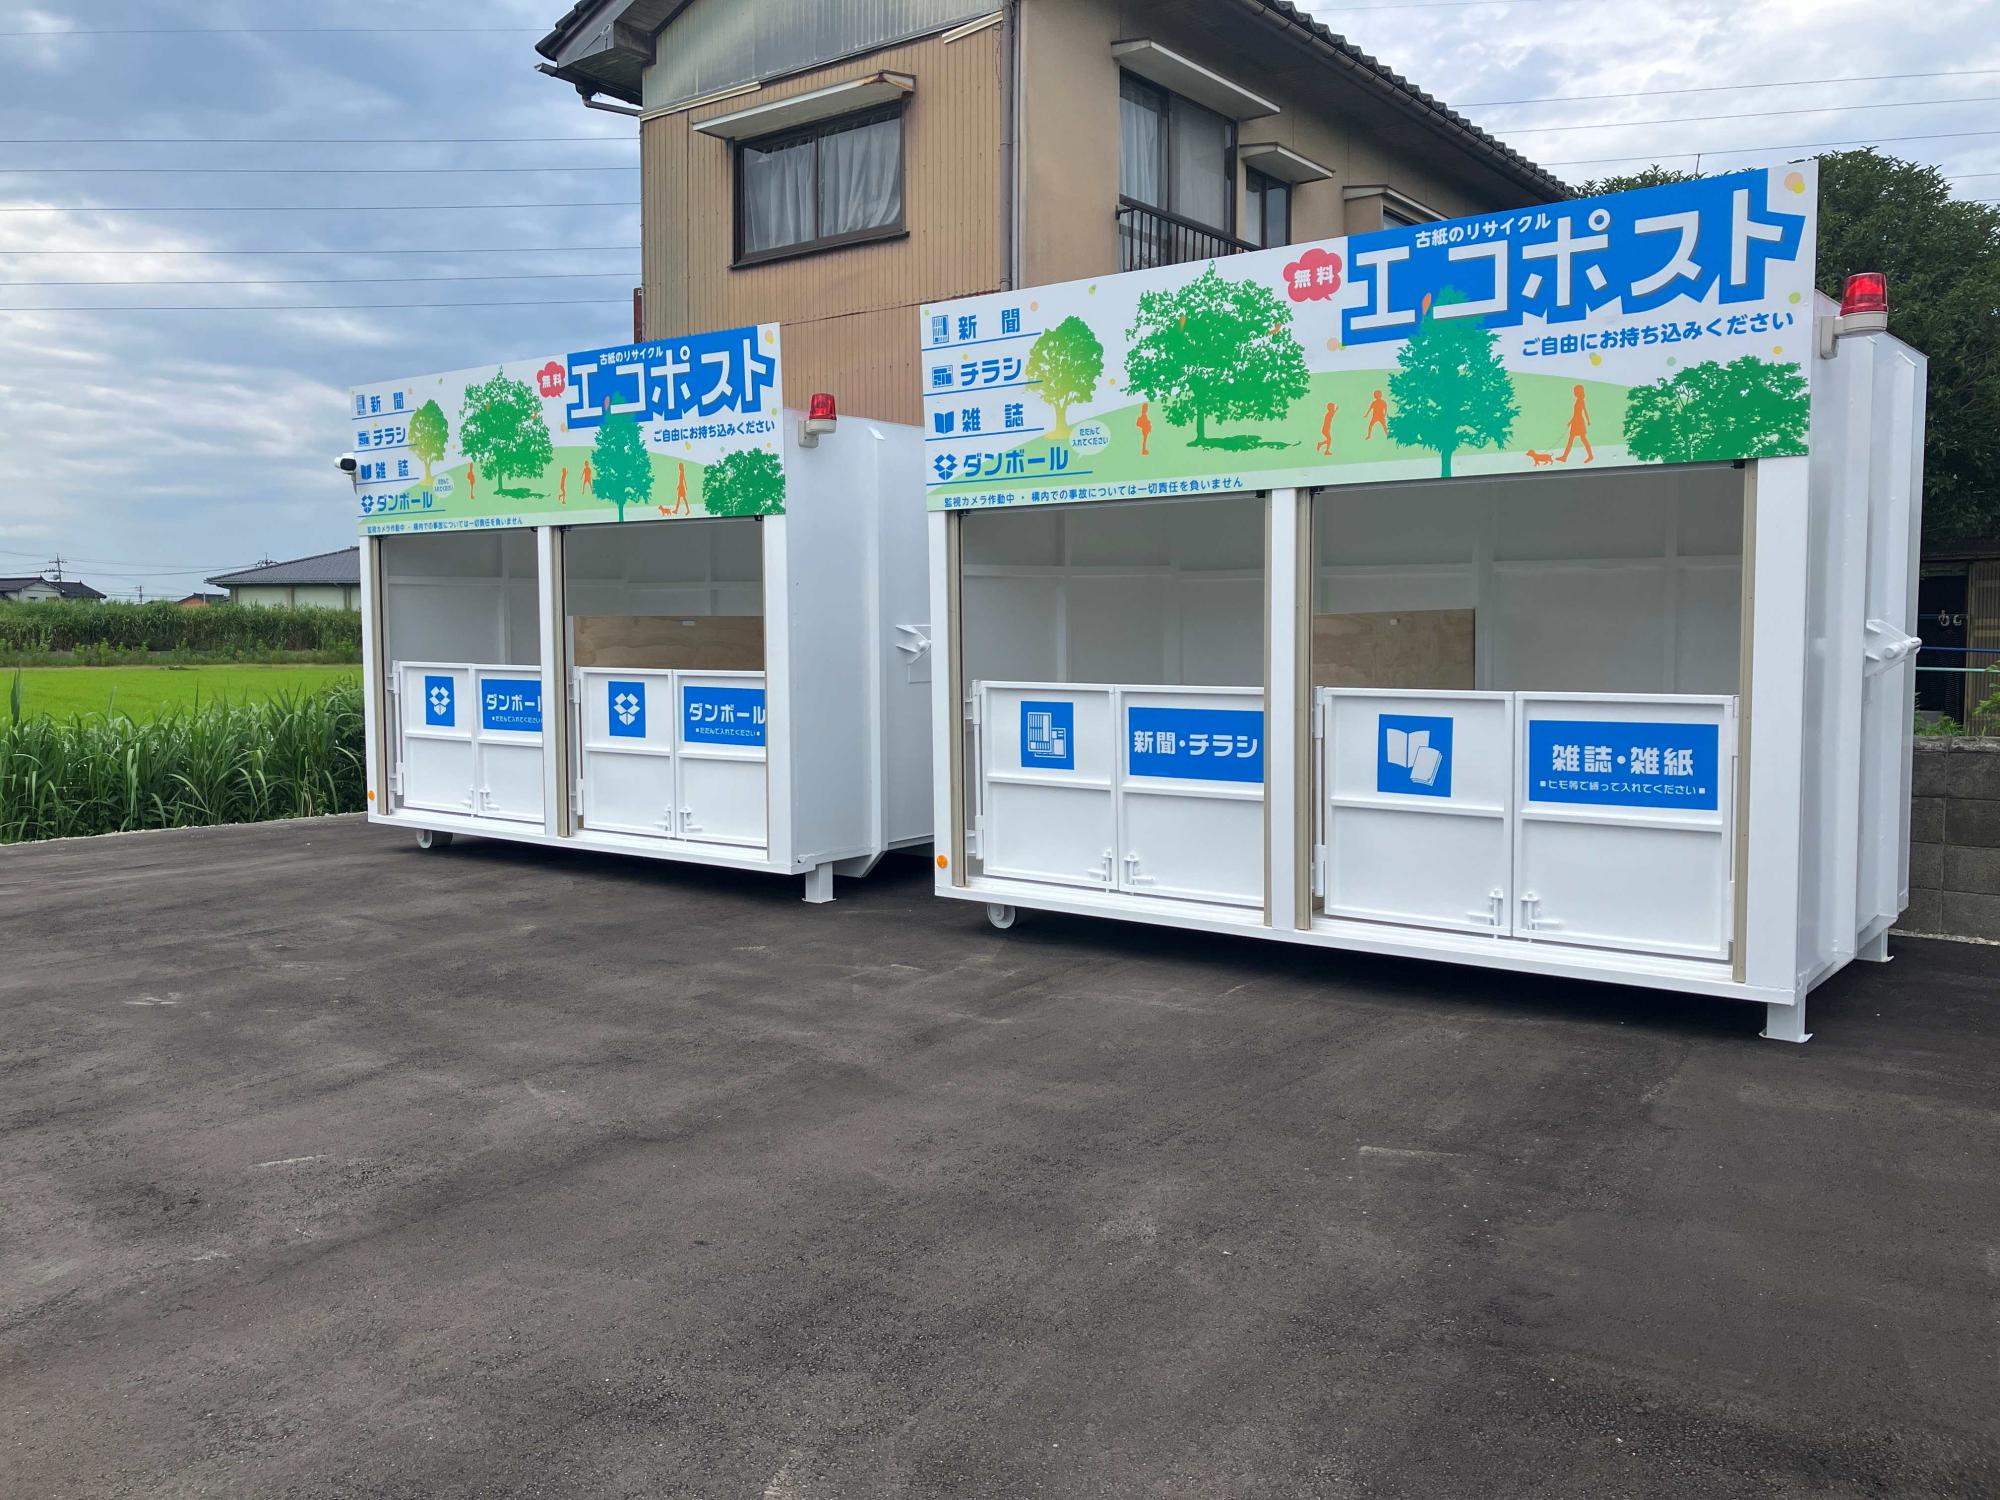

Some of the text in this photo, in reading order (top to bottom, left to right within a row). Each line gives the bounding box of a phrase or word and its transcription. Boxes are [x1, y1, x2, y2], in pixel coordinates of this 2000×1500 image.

[1415, 212, 1552, 248] 古紙のリサイクル
[1350, 188, 1784, 331] エコポスト
[1294, 264, 1335, 289] 無料
[1522, 311, 1794, 357] ご自由にお持ち込みください
[600, 345, 664, 366] 古紙のリサイクル
[541, 372, 562, 389] 無料
[570, 338, 767, 419] エコポスト
[960, 357, 1022, 386] チラシ
[373, 426, 406, 447] チラシ
[653, 420, 776, 443] ご自由にお持ち込みください
[963, 446, 1069, 478] ダンボール
[377, 490, 433, 512] ダンボール
[689, 702, 766, 725] ダンボール
[1133, 730, 1258, 759] 新聞・チラシ
[1551, 744, 1694, 777] 雑誌・雑紙
